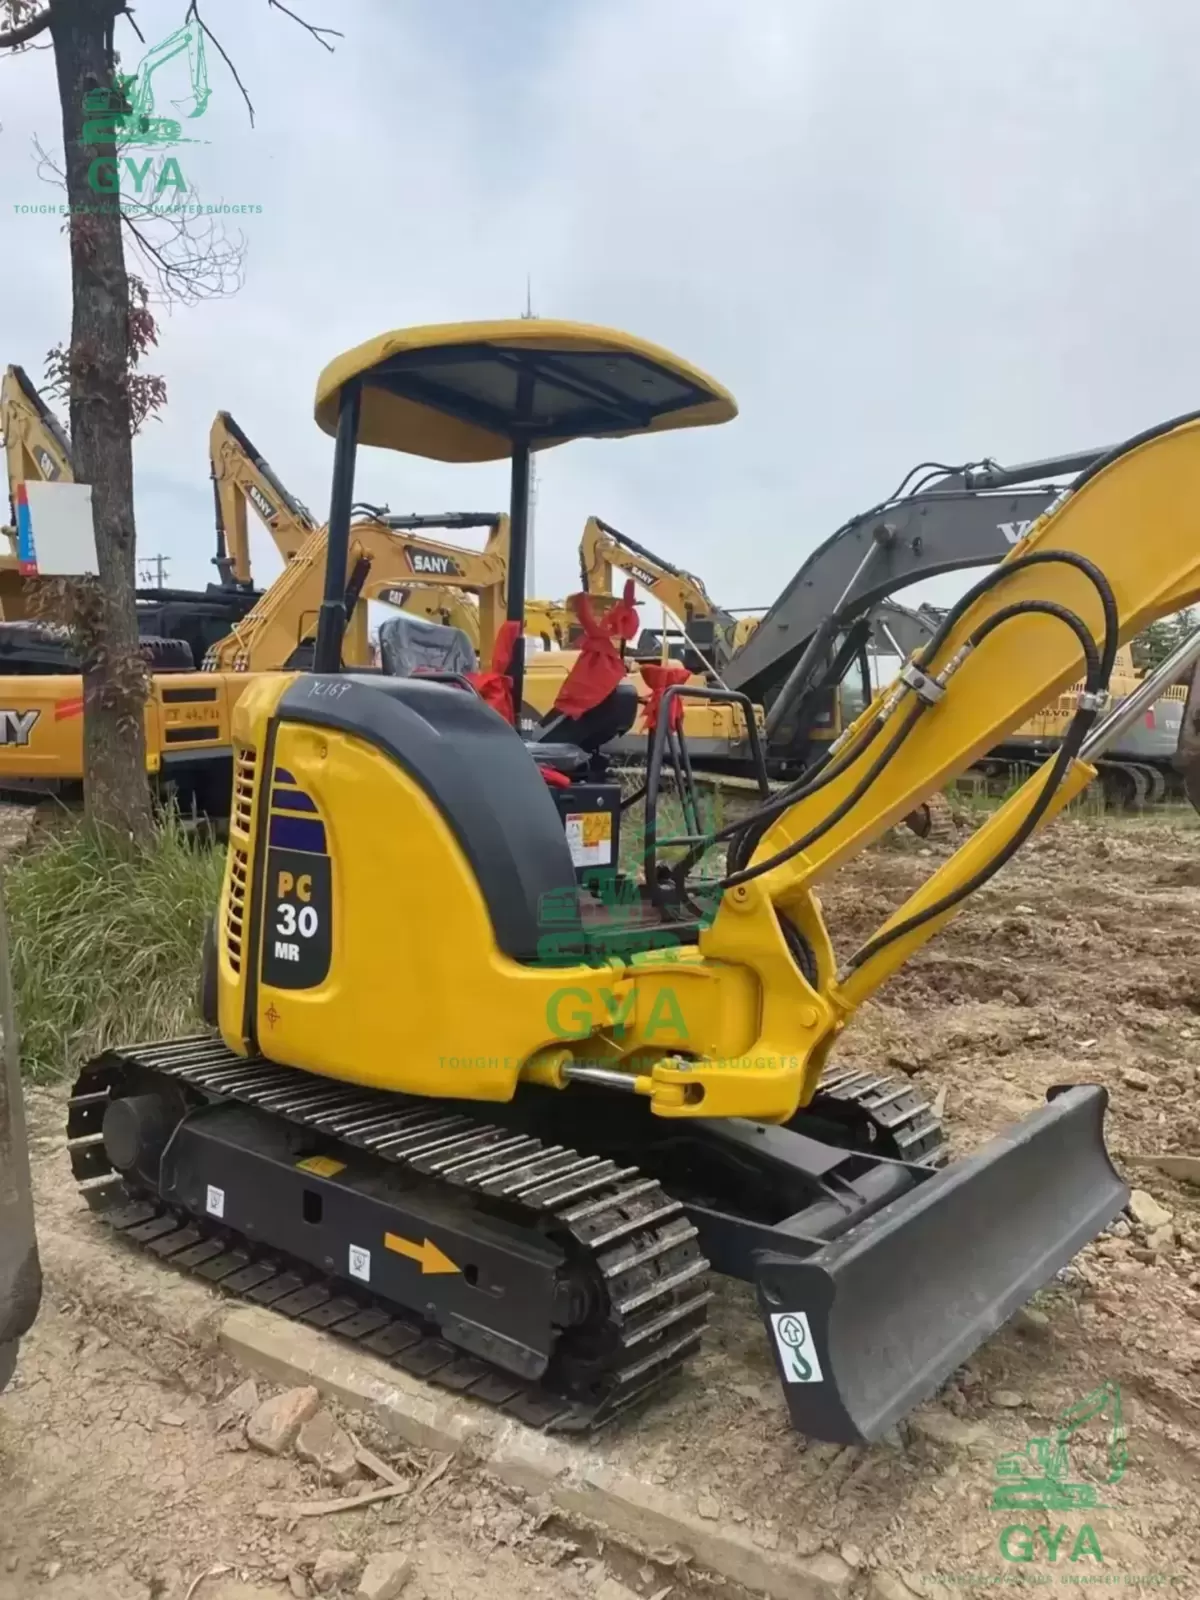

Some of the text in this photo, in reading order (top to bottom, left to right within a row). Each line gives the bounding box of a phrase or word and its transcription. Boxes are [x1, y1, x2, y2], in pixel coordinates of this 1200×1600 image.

[250, 486, 271, 516] SANY
[414, 555, 449, 573] SANY
[631, 566, 654, 584] SANY
[388, 589, 404, 605] CAT
[0, 709, 41, 747] Y
[278, 870, 313, 903] PC
[276, 903, 319, 938] 30
[274, 941, 300, 962] MR
